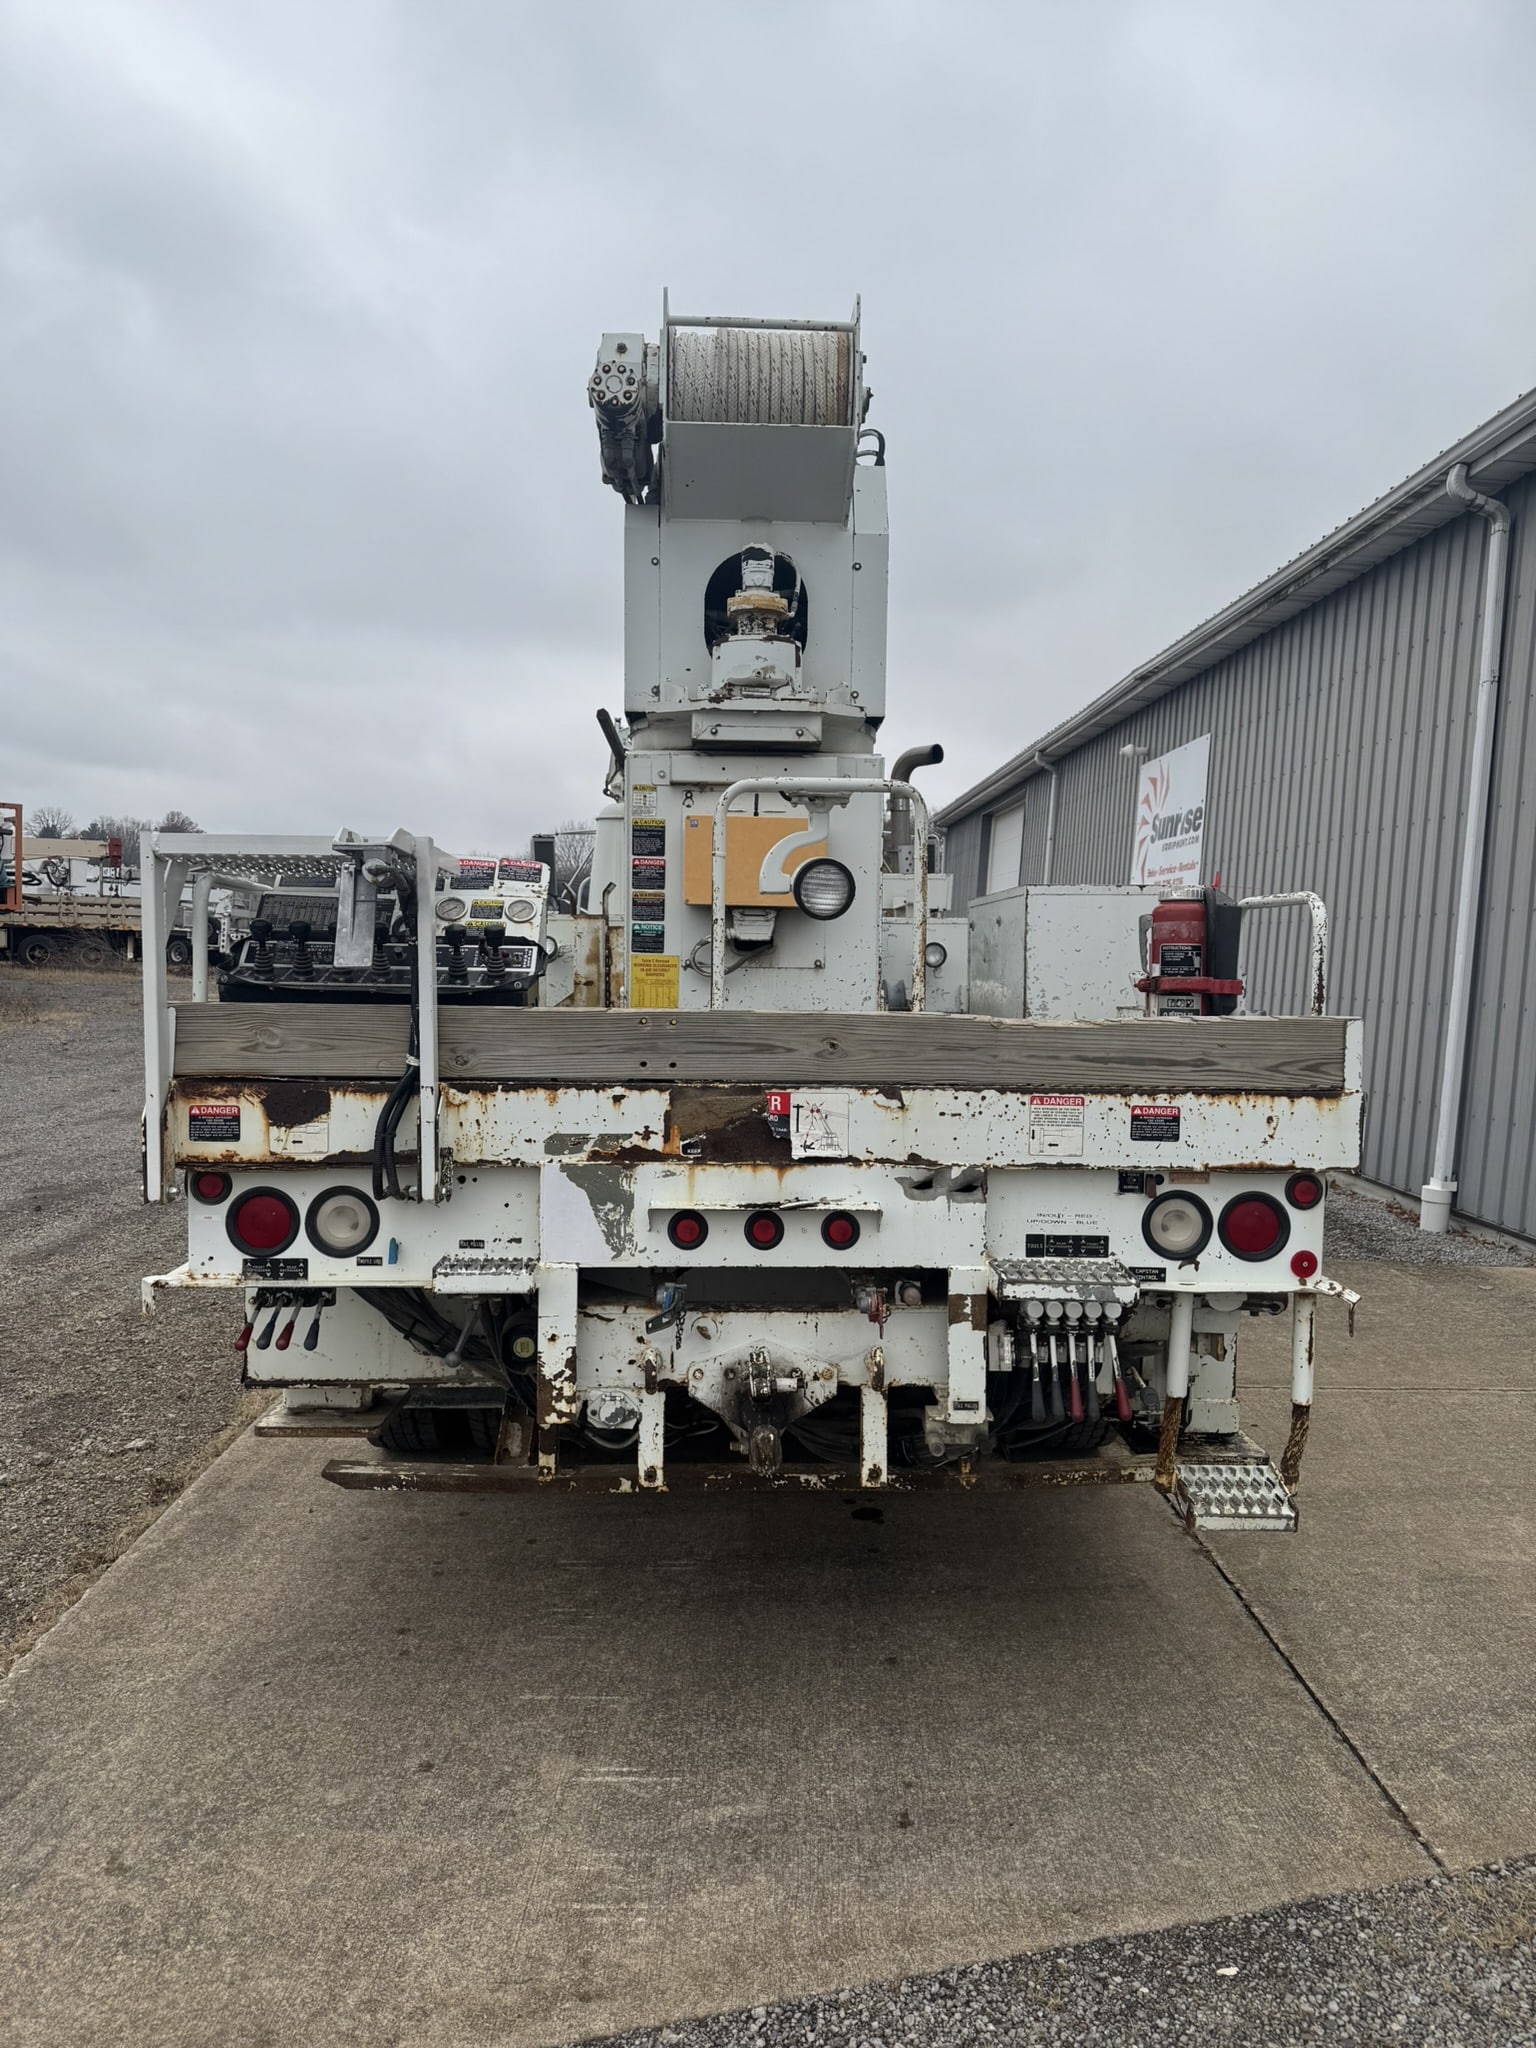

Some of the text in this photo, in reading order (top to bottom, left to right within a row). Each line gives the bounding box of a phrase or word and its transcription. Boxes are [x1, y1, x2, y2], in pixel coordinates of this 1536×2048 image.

[1150, 805, 1204, 844] Sunrise
[463, 860, 496, 868] DANGER
[510, 860, 541, 868] DANGER
[1043, 1097, 1083, 1106] DANGER
[201, 1106, 239, 1114] DANGER
[1142, 1107, 1179, 1115] DANGER
